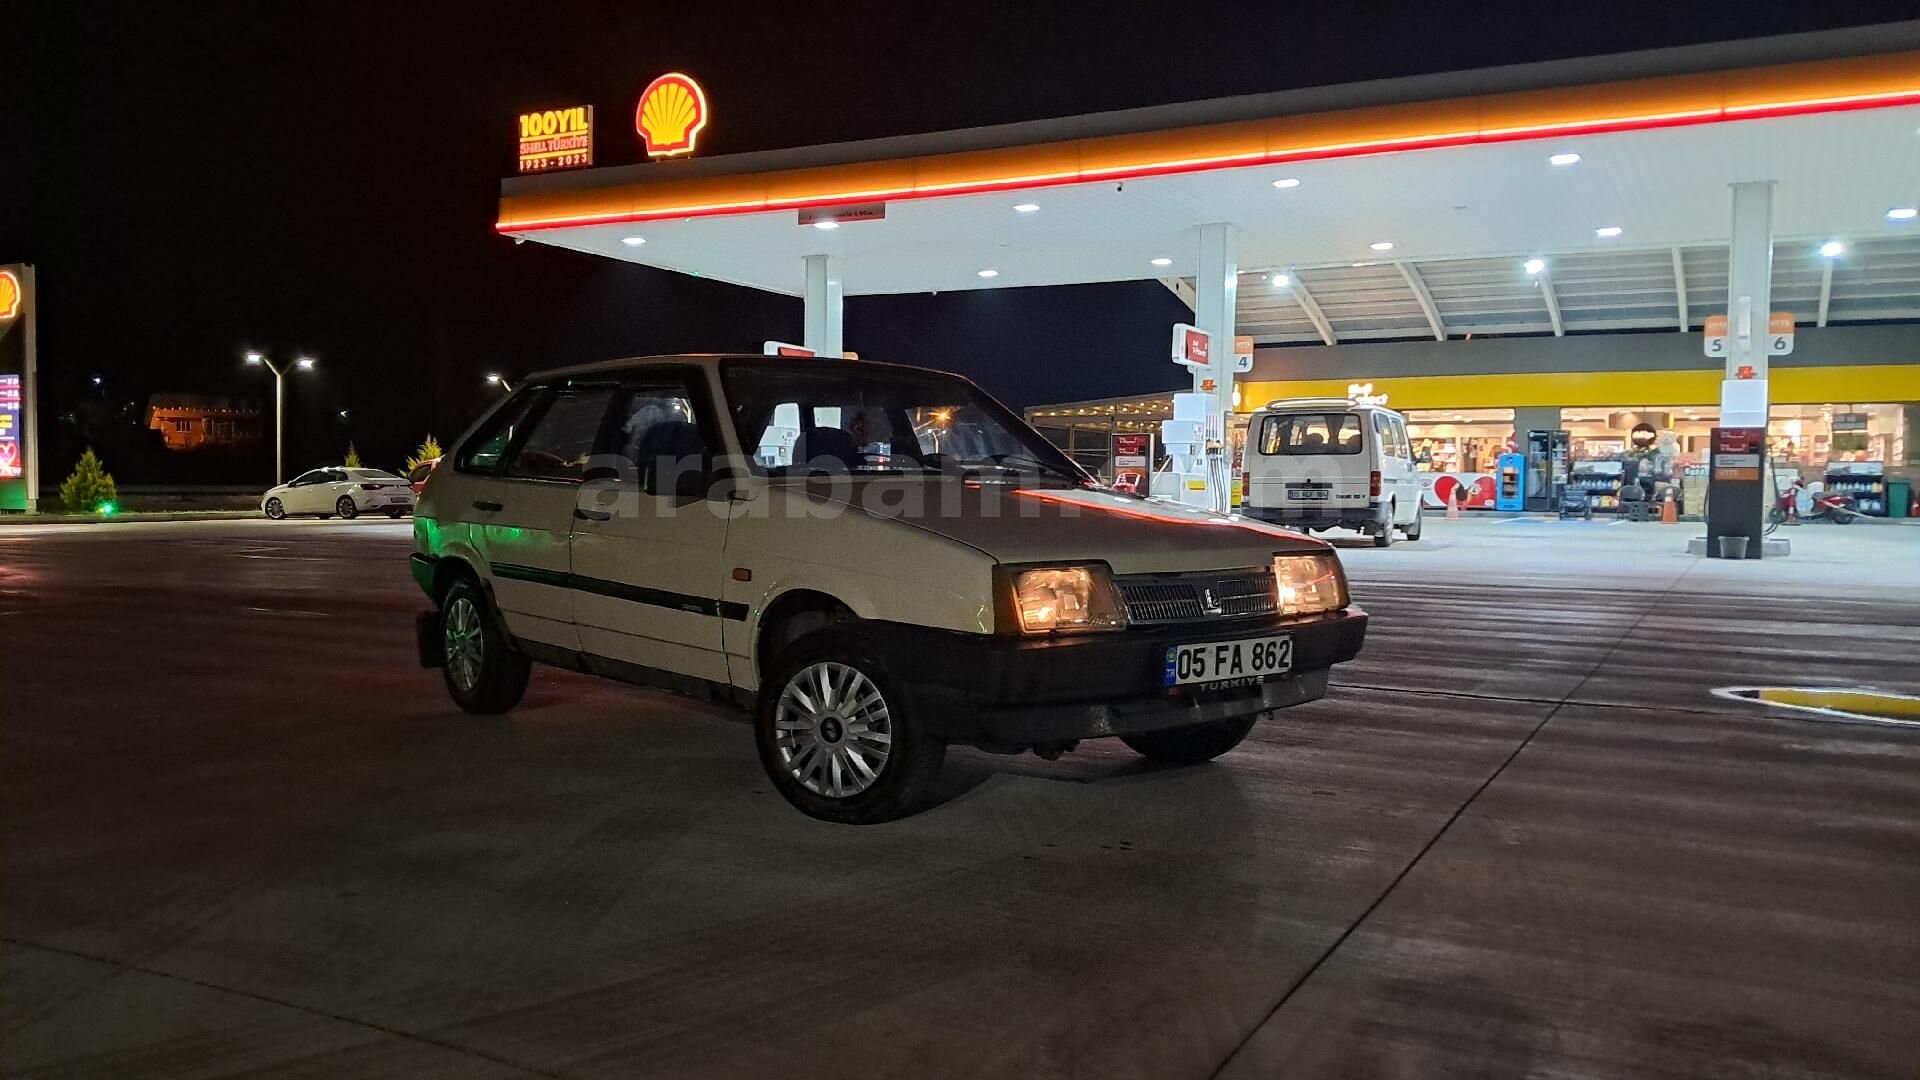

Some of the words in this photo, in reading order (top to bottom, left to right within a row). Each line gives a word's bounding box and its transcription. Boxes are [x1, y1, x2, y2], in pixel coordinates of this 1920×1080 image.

[520, 107, 588, 137] 100YIL
[520, 142, 548, 154] SHELL
[557, 153, 588, 166] 2023
[1711, 338, 1723, 352] 5
[1773, 336, 1787, 350] 6
[1238, 356, 1249, 368] 4
[1177, 647, 1206, 680] 05
[1215, 645, 1243, 676] FA
[1251, 640, 1290, 672] 862
